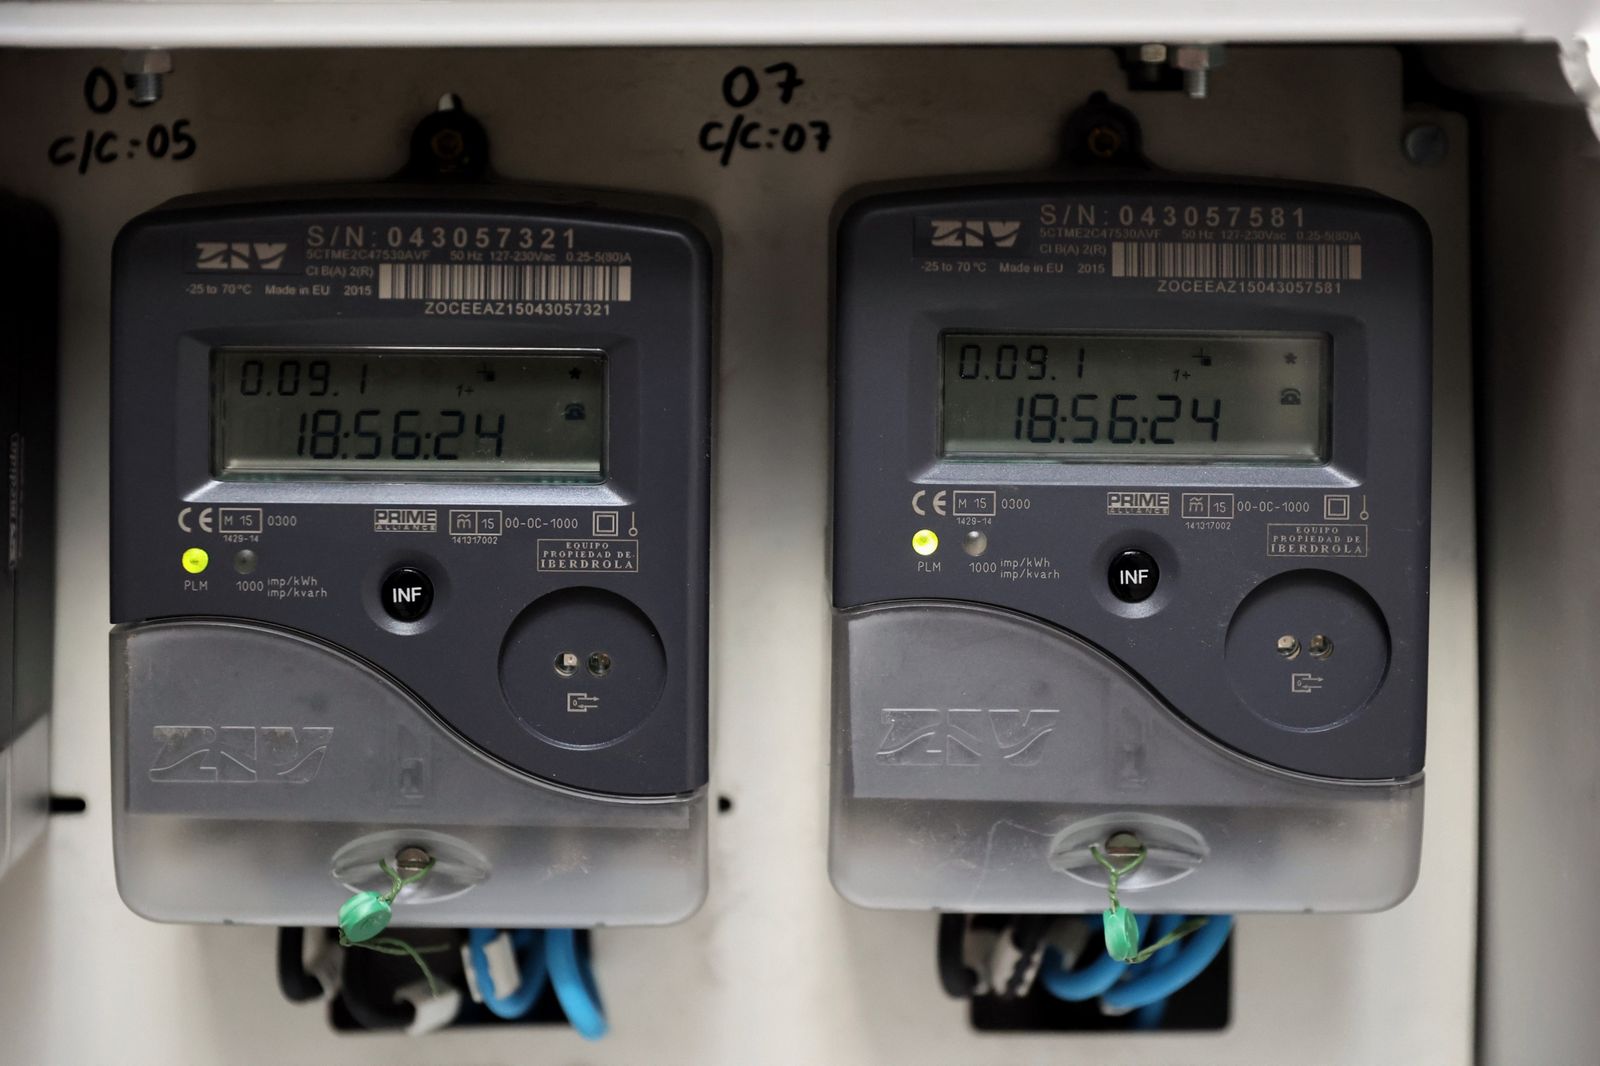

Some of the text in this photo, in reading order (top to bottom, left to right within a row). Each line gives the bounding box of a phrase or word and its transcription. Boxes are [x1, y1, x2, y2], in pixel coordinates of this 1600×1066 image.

[83, 66, 155, 115] 0
[722, 62, 804, 108] 07
[1040, 204, 1304, 228] S/N: 043057581
[307, 226, 575, 249] S/N: 043057321
[1082, 244, 1107, 256] 2(R)
[350, 264, 375, 278] 2(R)
[942, 262, 953, 273] to
[1000, 262, 1105, 275] Made in EU 2015
[206, 284, 218, 295] to
[265, 284, 372, 297] Made in EU 2015
[1015, 393, 1222, 445] 18:56:24
[297, 409, 506, 460] 18:56:24
[958, 498, 987, 509] M 15
[1001, 498, 1031, 510] 0300
[1107, 493, 1169, 508] PRIME
[1213, 501, 1226, 513] 15
[224, 515, 253, 526] M 15
[267, 515, 297, 527] 0300
[374, 509, 437, 524] PRIME
[956, 516, 992, 526] 1429-14
[481, 518, 495, 530] 15
[1185, 521, 1231, 531] 141317002
[1296, 526, 1339, 535] EQUIPO
[223, 534, 260, 544] 1429-14
[451, 536, 498, 545] 141317002
[1273, 535, 1362, 543] PROPIEDAD DE
[565, 541, 609, 550] EQUIPO
[1271, 544, 1363, 554] IBERDROLA
[543, 551, 632, 559] PROPIEDAD DE
[540, 559, 633, 570] IBERDROLA
[917, 561, 941, 573] PLM
[969, 561, 997, 574] 1000
[1001, 557, 1050, 569] imp/kWh
[1001, 568, 1060, 580] imp/kvarh
[1120, 569, 1149, 585] INF
[184, 580, 208, 592] PLM
[236, 580, 264, 593] 1000
[267, 576, 318, 587] imp/kWh
[267, 588, 327, 599] imp/kvarh
[392, 586, 422, 604] INF
